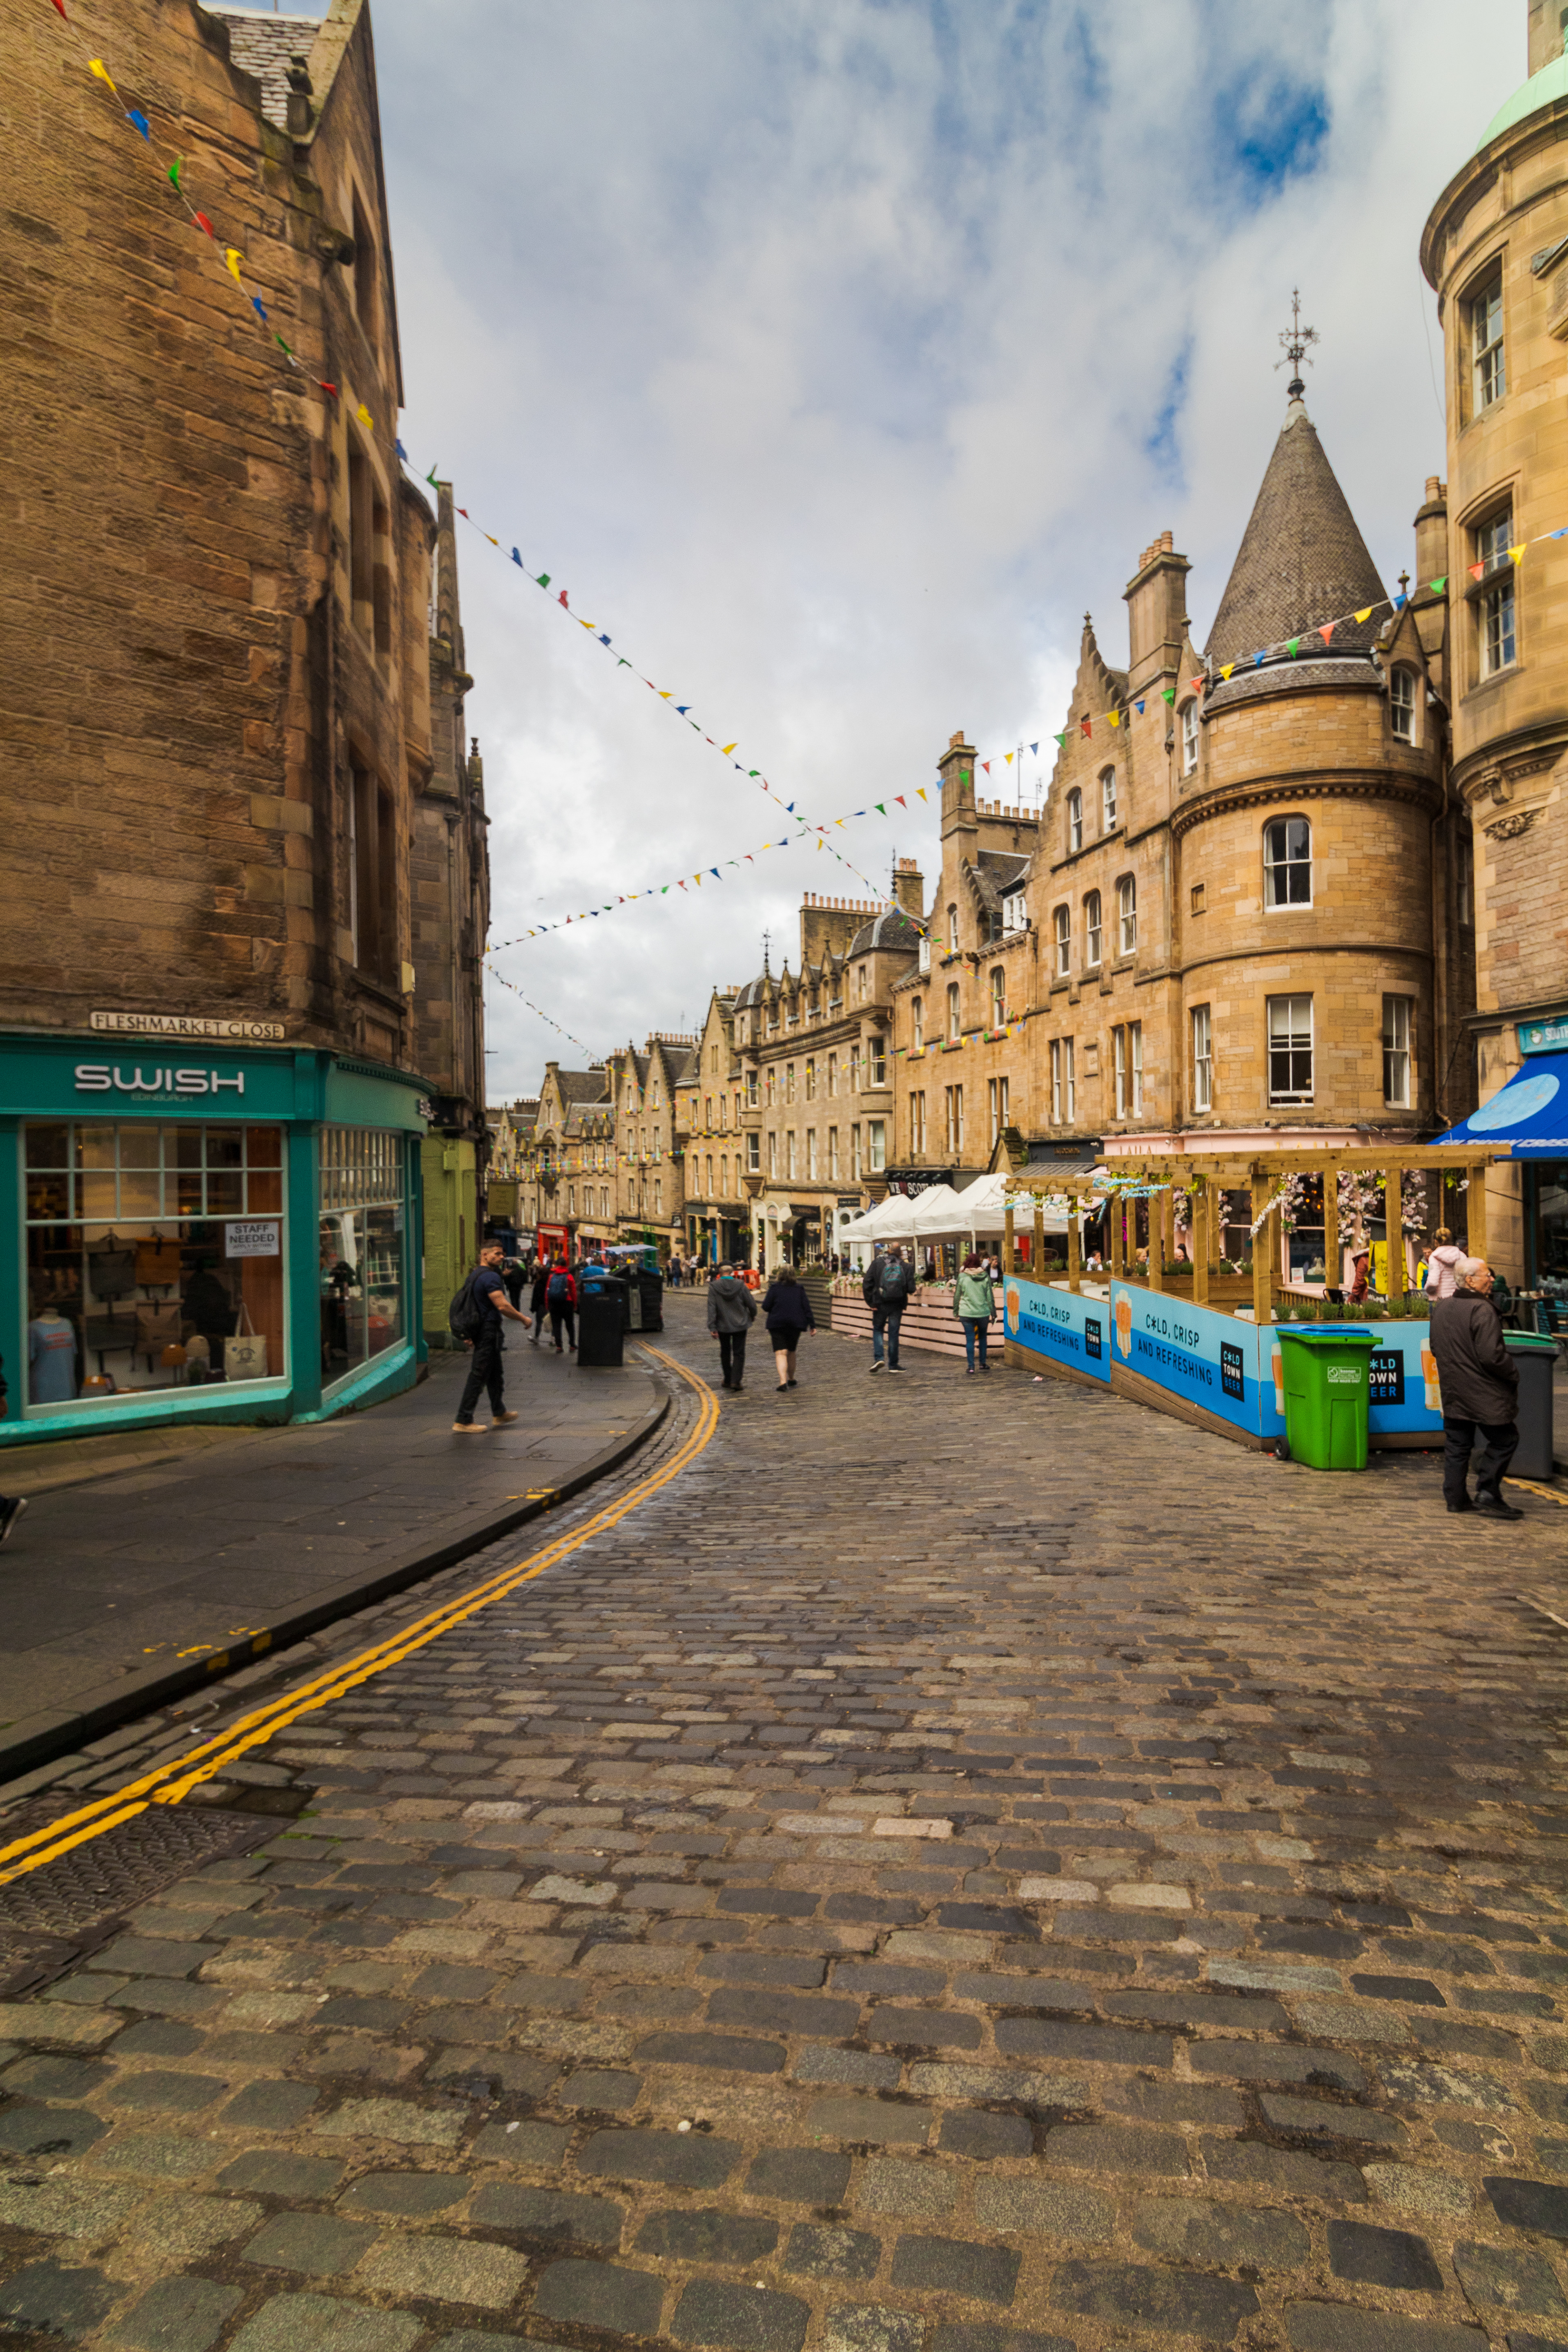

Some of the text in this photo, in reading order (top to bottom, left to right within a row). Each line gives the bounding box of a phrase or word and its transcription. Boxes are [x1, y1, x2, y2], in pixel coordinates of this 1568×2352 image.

[96, 1014, 281, 1038] FLESHMARKET CLOSE
[74, 1065, 244, 1093] SWISH
[888, 1182, 901, 1194] WE
[235, 1224, 269, 1234] STAFF
[229, 1234, 275, 1243] NEEDED
[1051, 1307, 1070, 1323] CRISP
[1024, 1319, 1079, 1350] AND REFRESHING
[1087, 1333, 1100, 1344] TOWN
[1174, 1324, 1199, 1348] CRISP
[1087, 1342, 1100, 1354] BEER
[1138, 1338, 1212, 1385] AND REFRESHING
[1223, 1363, 1240, 1379] TOWN
[1369, 1372, 1397, 1383] OWN
[1224, 1376, 1241, 1393] BEER
[1370, 1386, 1396, 1397] EER
